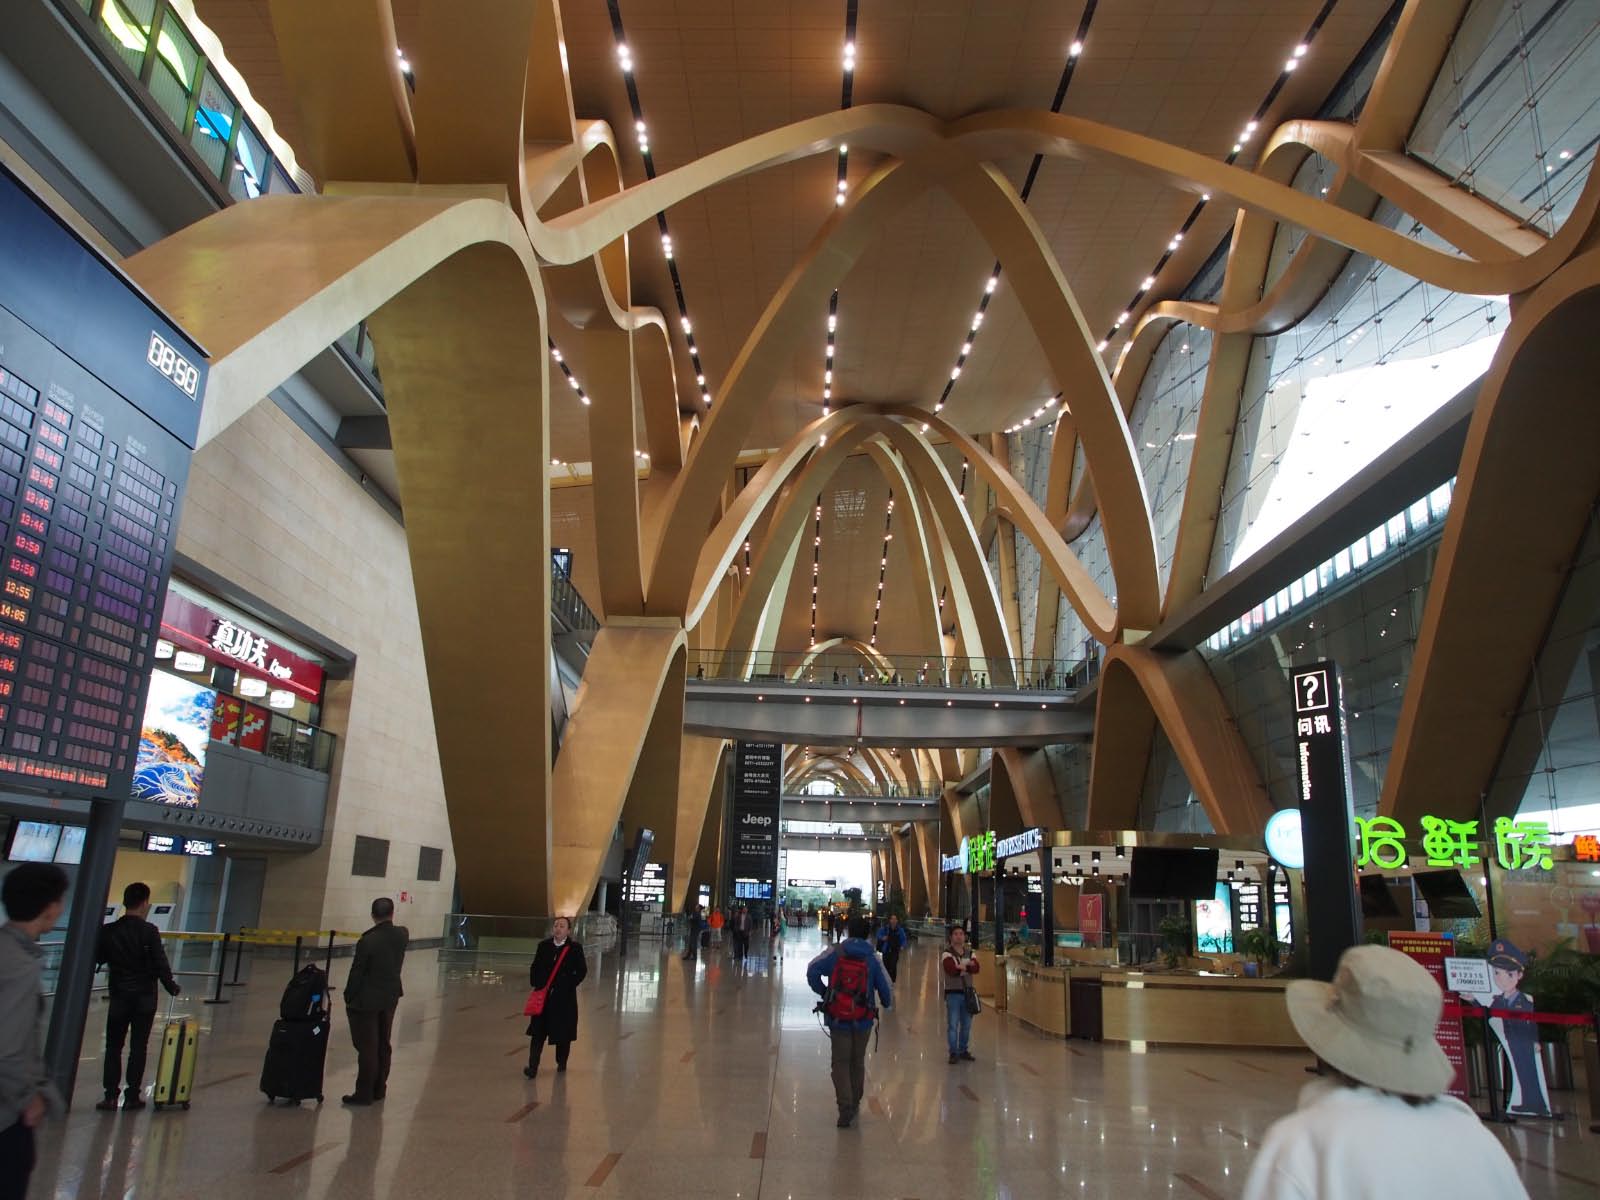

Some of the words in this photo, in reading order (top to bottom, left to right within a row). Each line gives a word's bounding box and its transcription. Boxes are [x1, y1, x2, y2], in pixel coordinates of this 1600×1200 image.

[20, 512, 45, 533] 13:46
[5, 581, 31, 600] 13:55
[212, 619, 269, 669] 真功夫
[1297, 715, 1331, 736] 问讯
[1299, 742, 1312, 800] Information
[742, 813, 772, 826] Jeep
